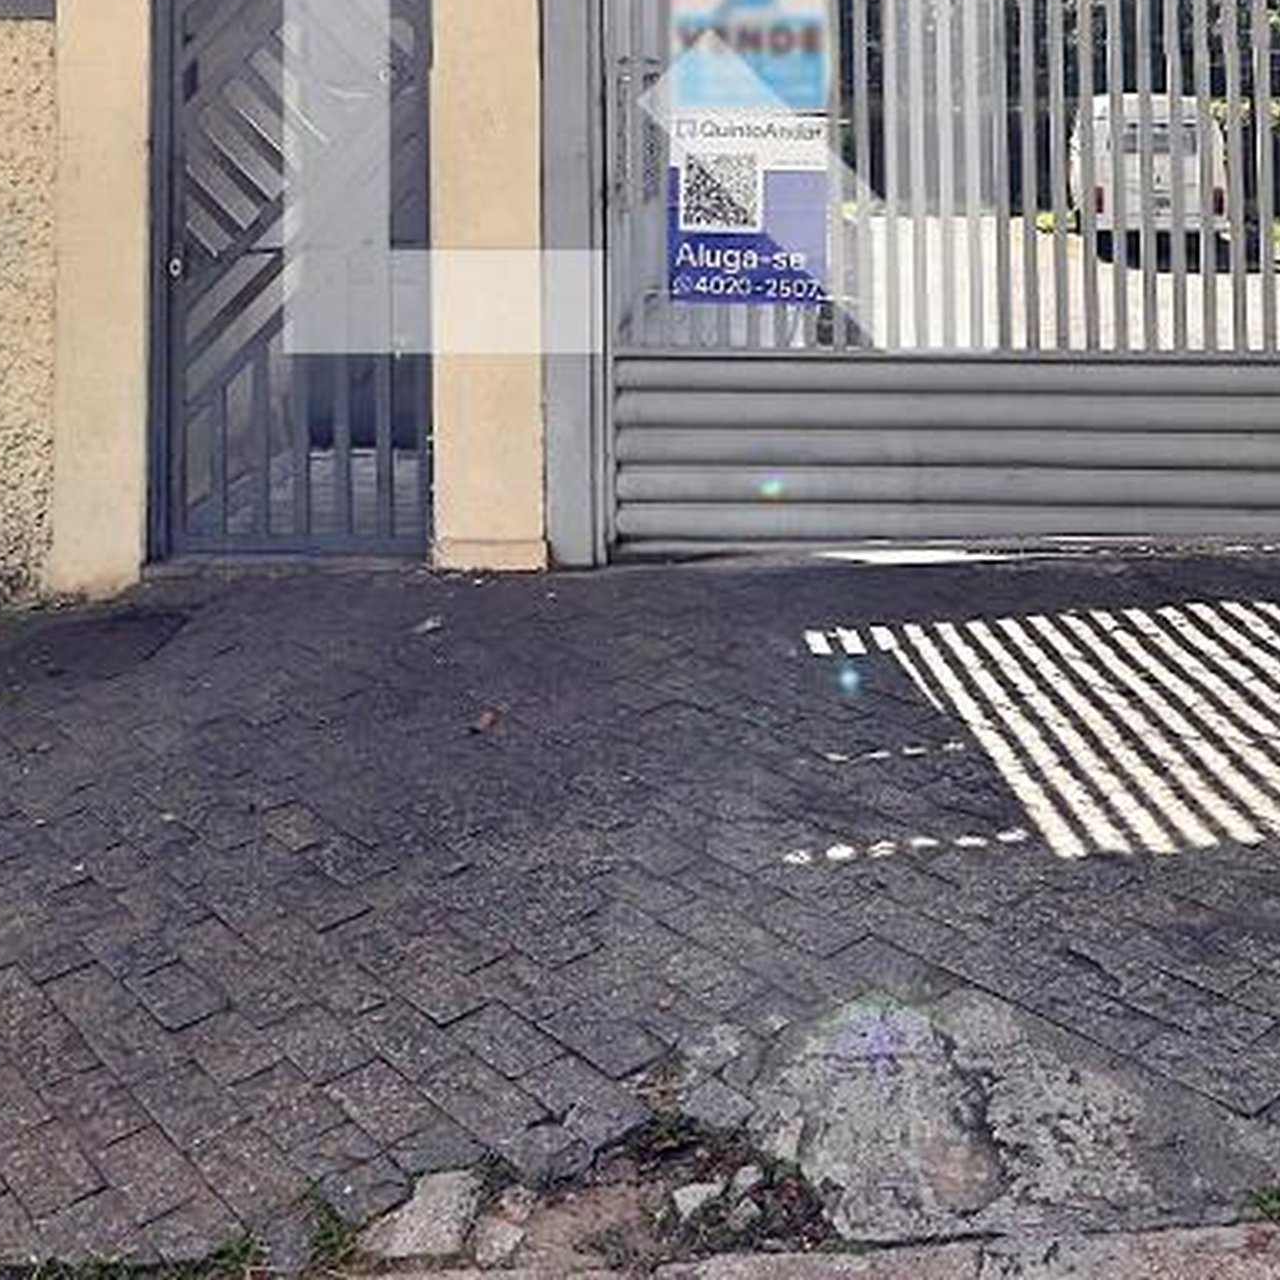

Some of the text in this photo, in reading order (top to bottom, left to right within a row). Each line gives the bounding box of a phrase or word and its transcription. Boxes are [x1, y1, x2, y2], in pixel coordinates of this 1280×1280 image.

[674, 25, 823, 52] VNDE
[700, 120, 821, 140] QuintoAndar
[675, 242, 805, 274] Aluga-se
